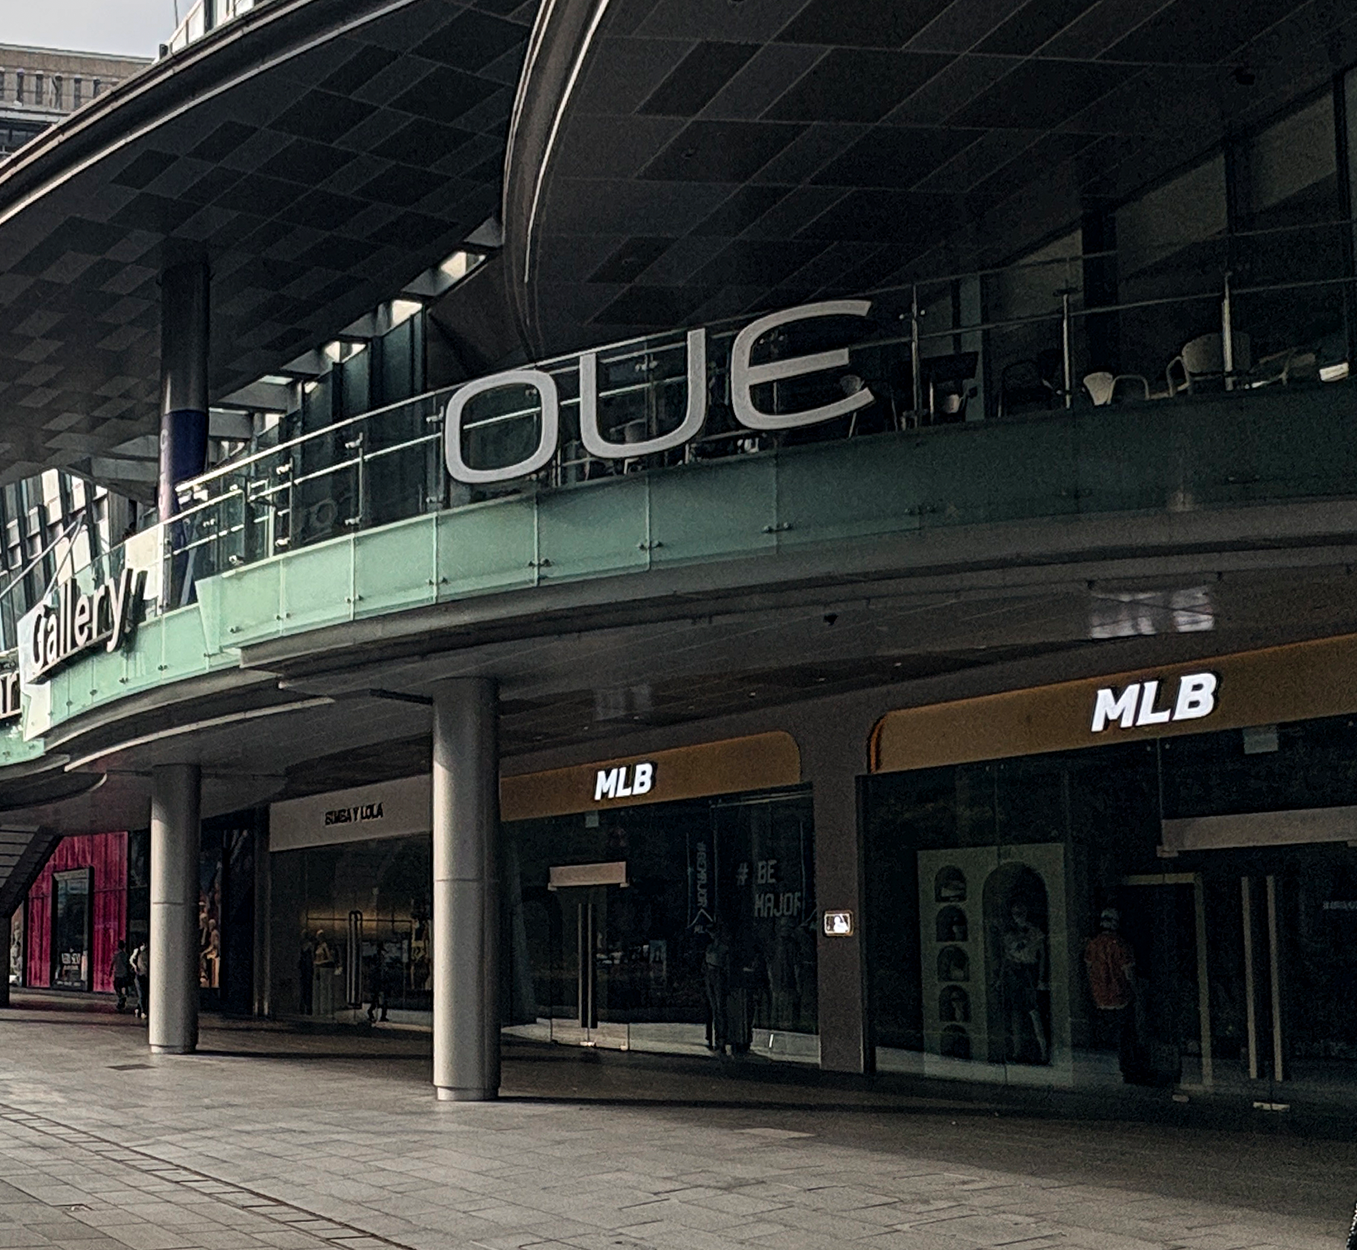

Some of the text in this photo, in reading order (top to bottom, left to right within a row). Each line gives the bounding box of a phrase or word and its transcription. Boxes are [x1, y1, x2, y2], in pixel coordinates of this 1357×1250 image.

[445, 300, 875, 484] OUE
[32, 567, 129, 671] Gallery
[1091, 672, 1217, 732] MLB
[594, 762, 653, 801] MLB
[360, 801, 384, 820] LOLA
[757, 859, 778, 885] BE
